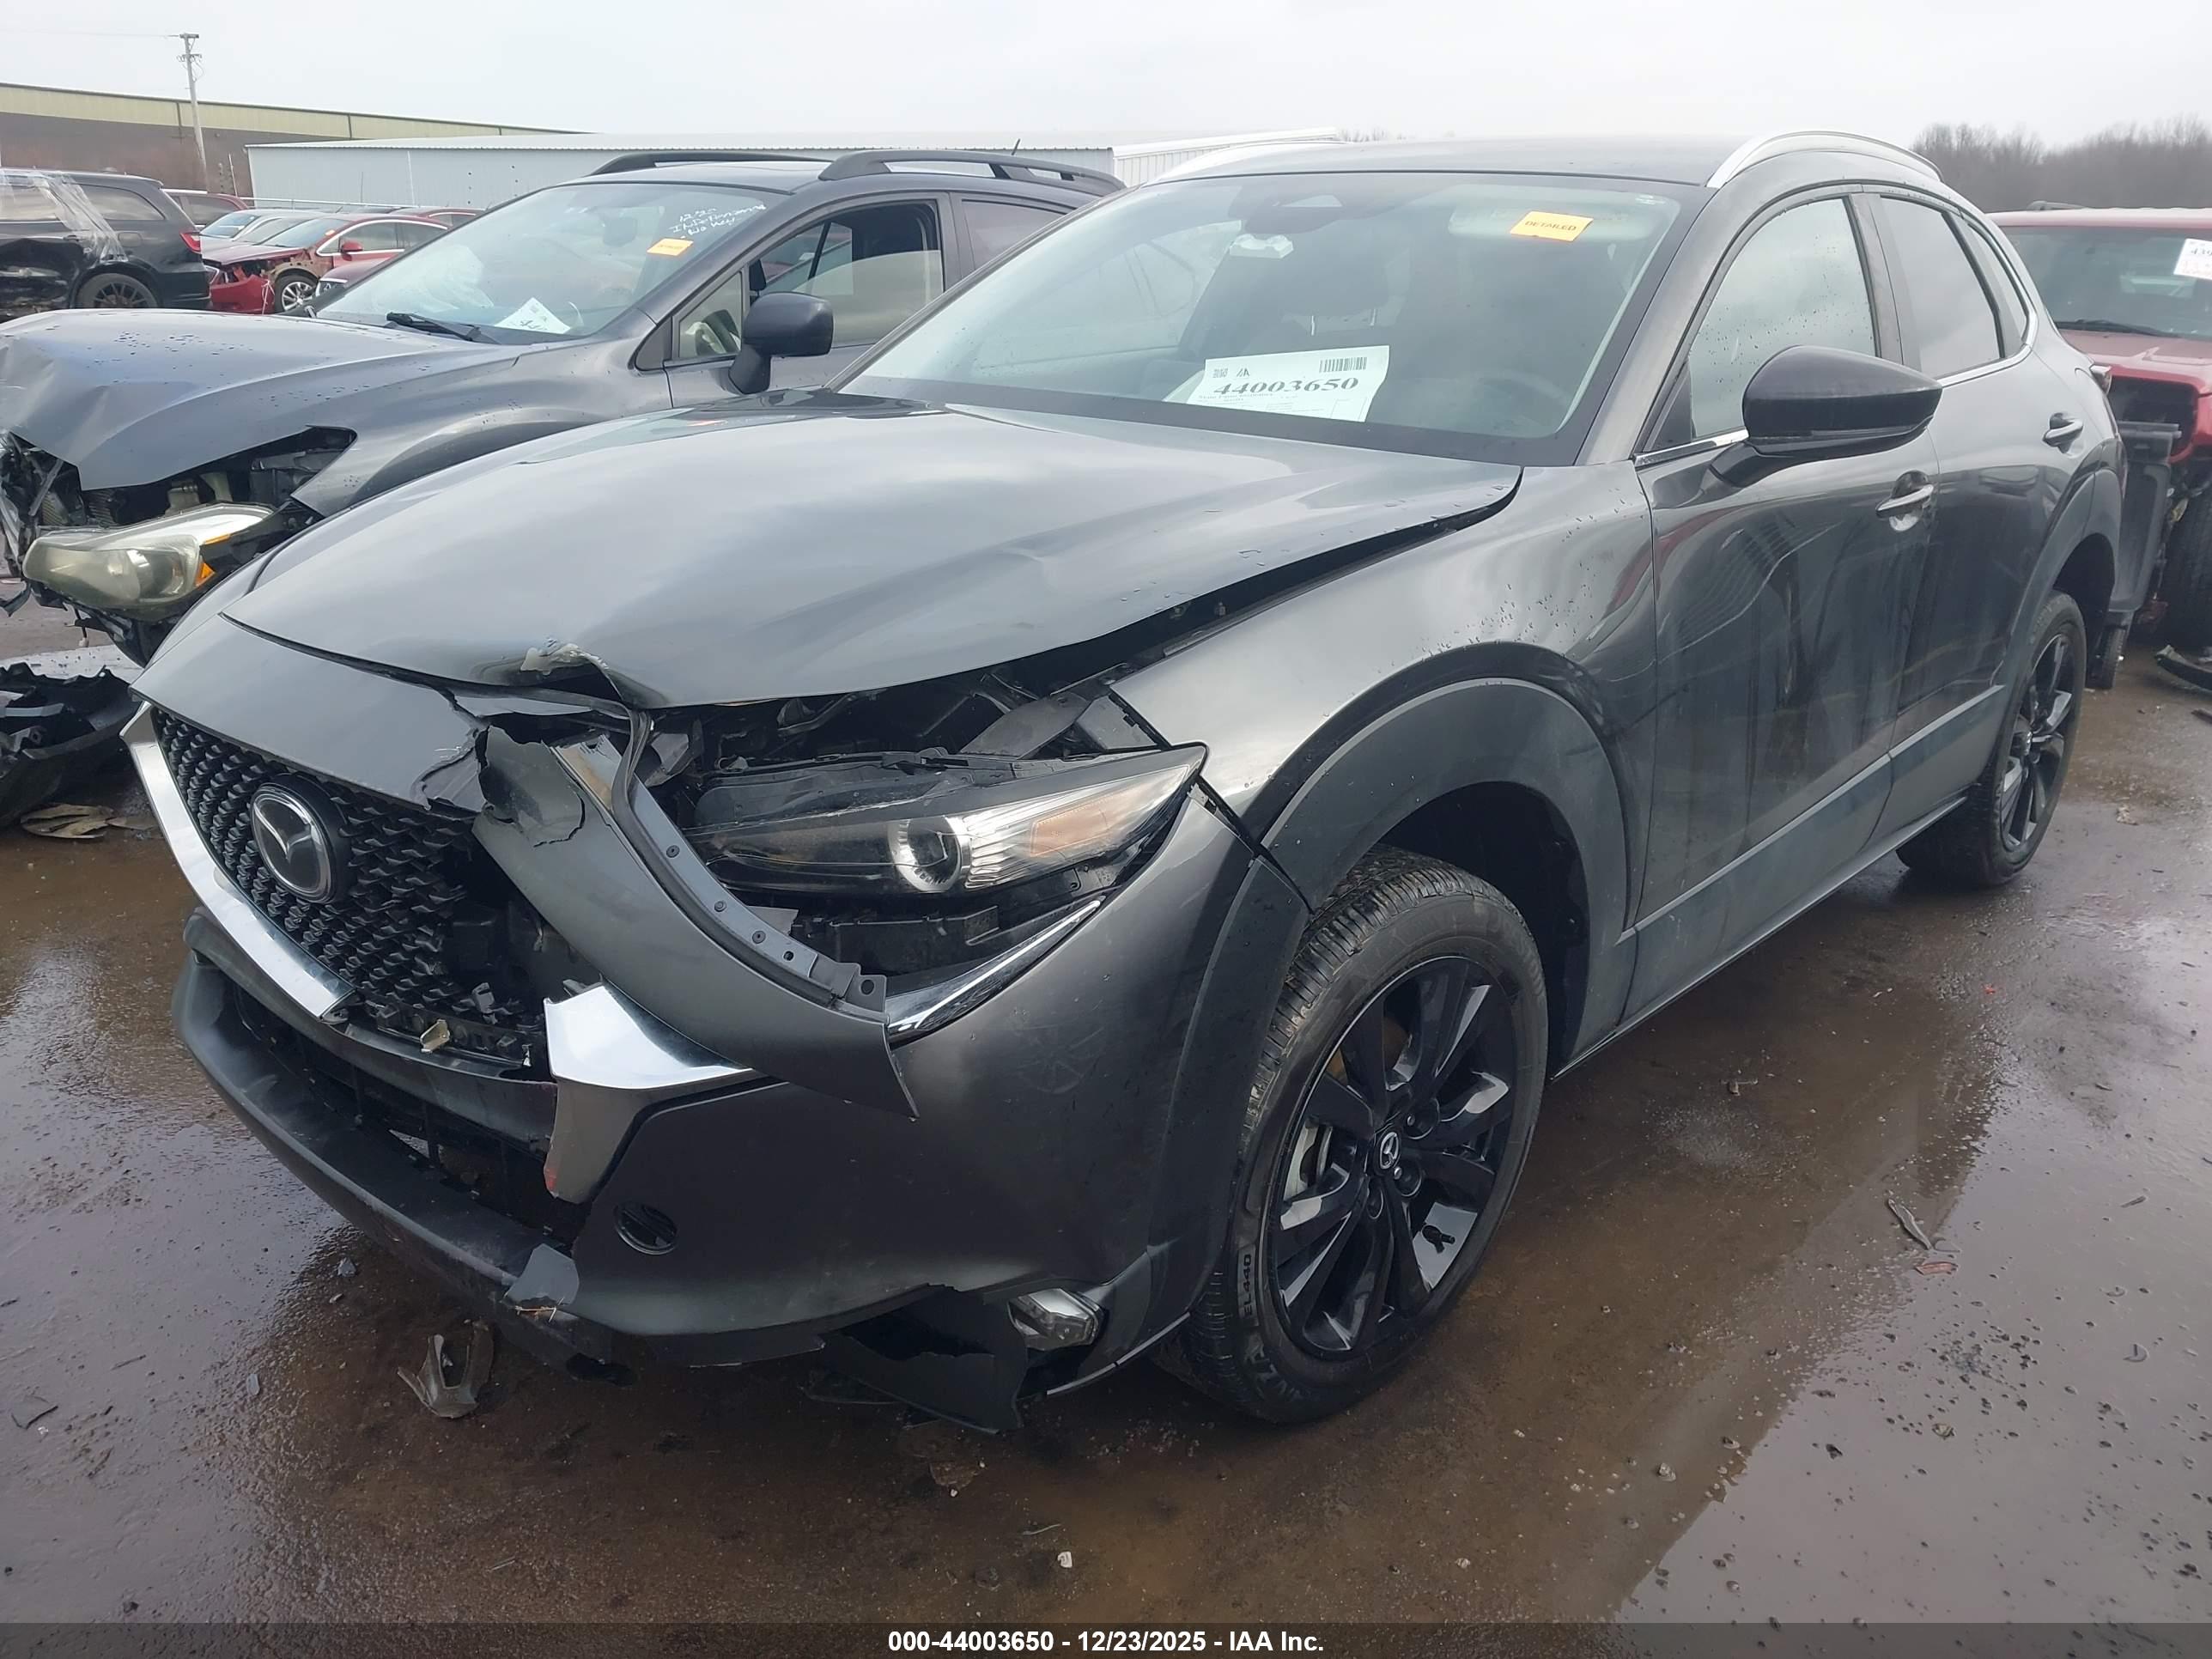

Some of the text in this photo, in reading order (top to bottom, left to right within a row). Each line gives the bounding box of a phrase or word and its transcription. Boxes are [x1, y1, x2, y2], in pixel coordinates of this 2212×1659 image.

[1524, 221, 1577, 231] DETAILED
[1213, 377, 1359, 395] 44003650
[1243, 1254, 1253, 1316] EL440
